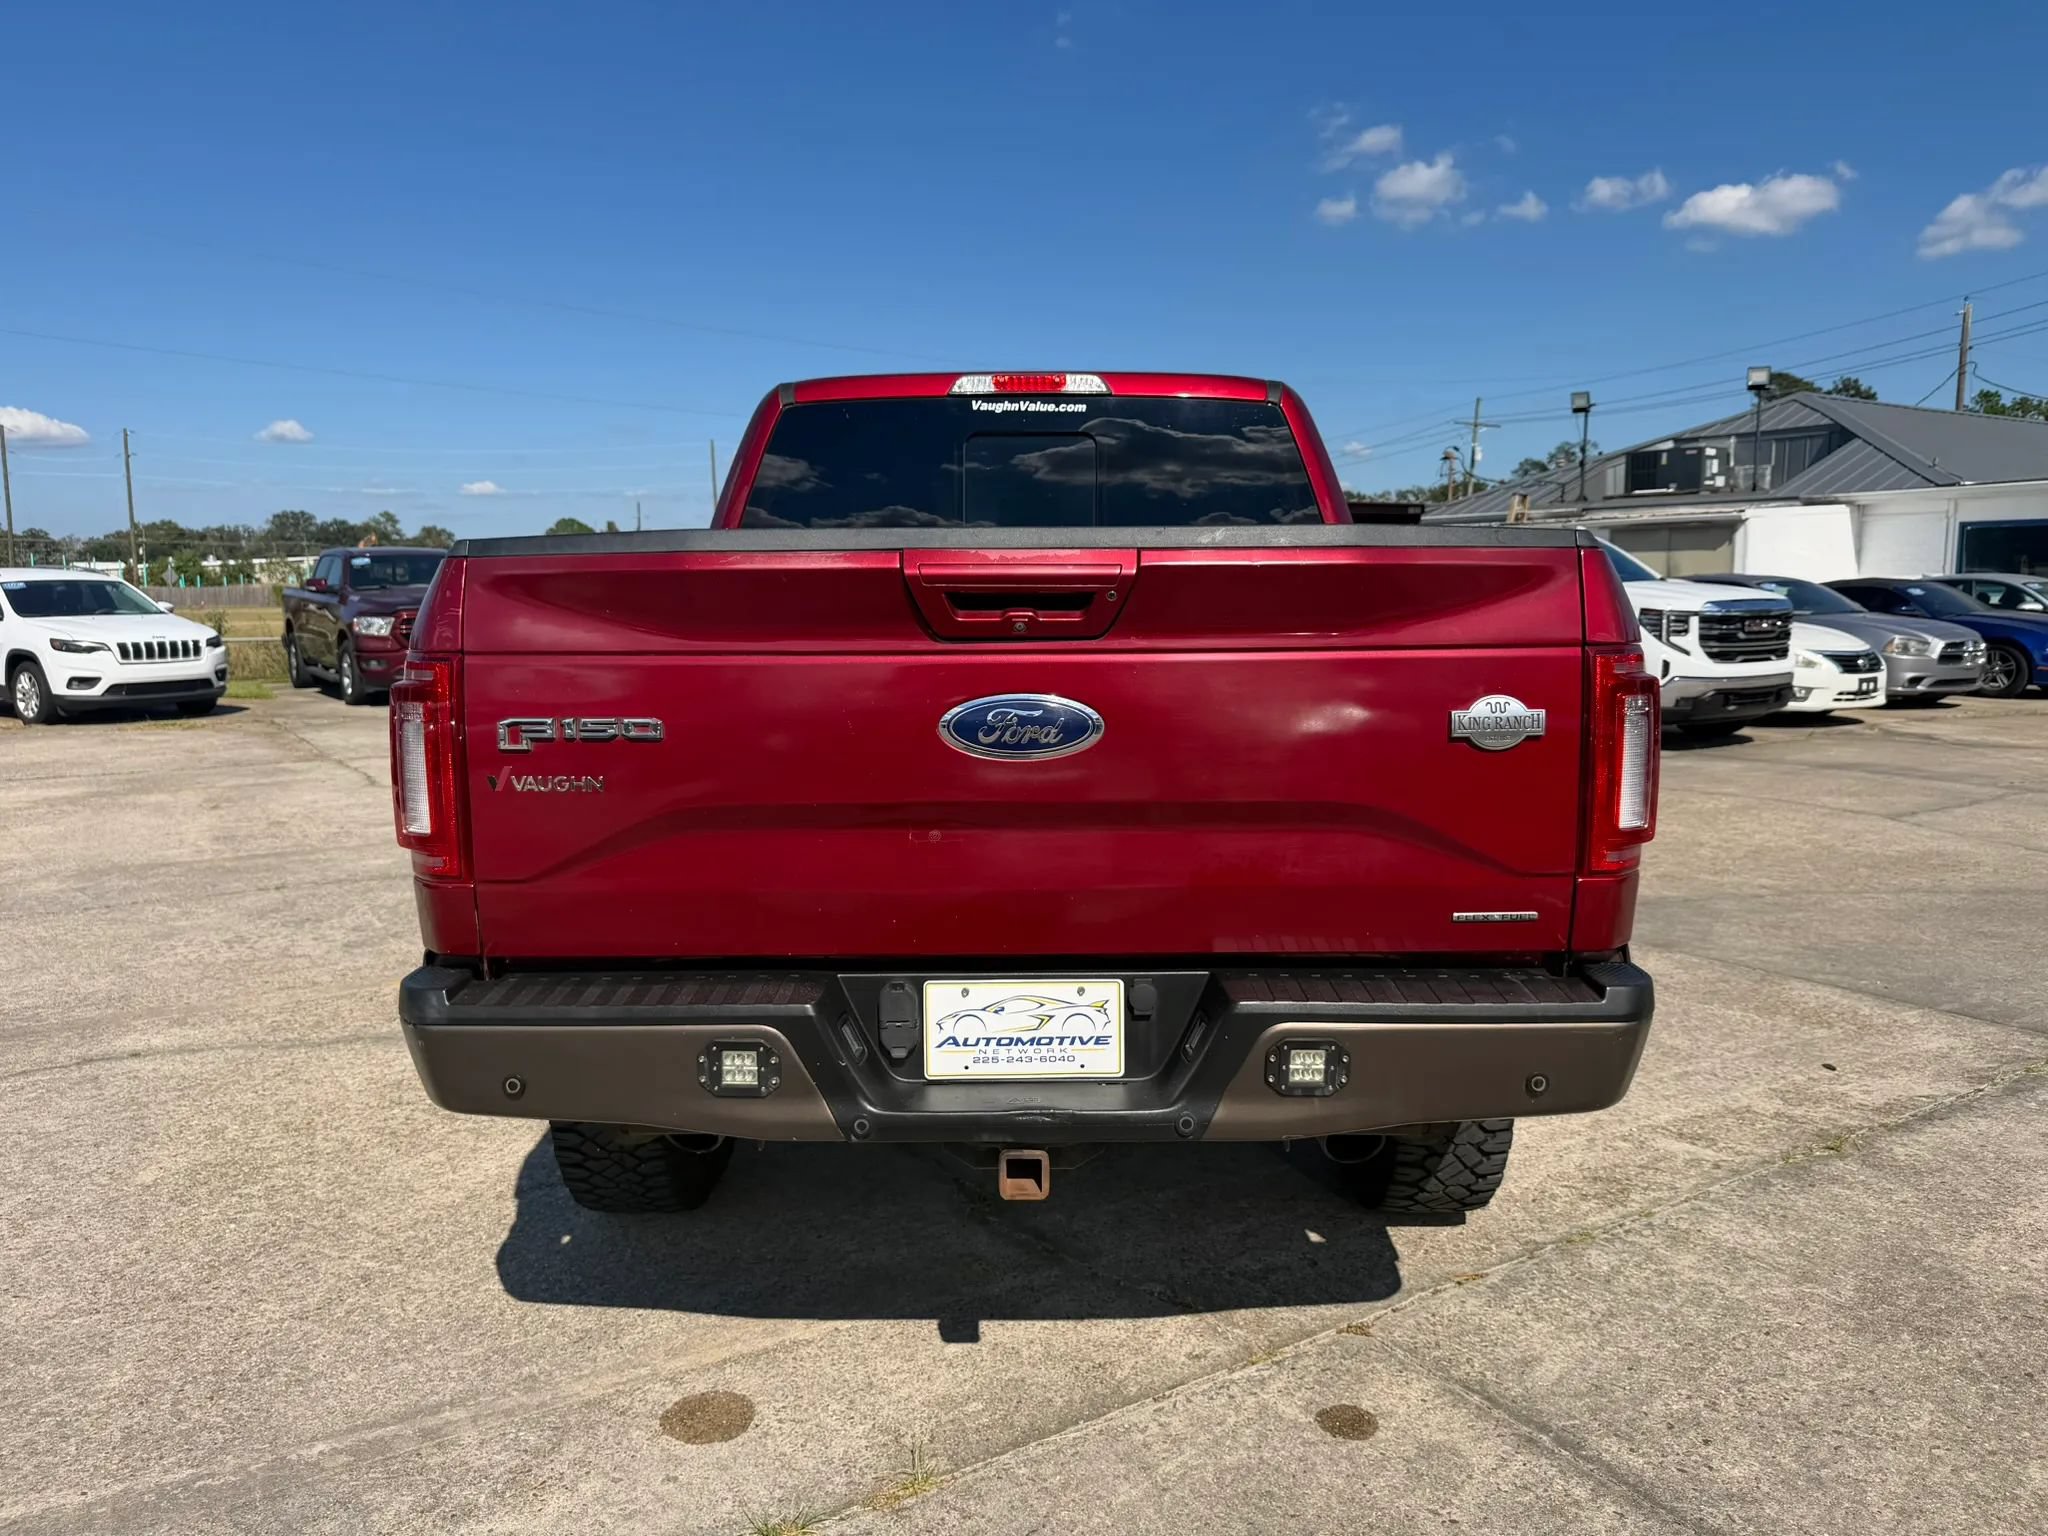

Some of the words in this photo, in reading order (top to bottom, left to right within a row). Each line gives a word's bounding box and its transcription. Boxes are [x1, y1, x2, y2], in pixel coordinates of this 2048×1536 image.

[971, 400, 1087, 413] VaughnValue.com
[977, 708, 1064, 744] Ford
[1457, 714, 1490, 731] KING
[1495, 713, 1541, 731] RANCH
[511, 775, 604, 792] VAUGHN
[935, 1035, 1112, 1048] AUTOMOTIVE
[972, 1055, 1076, 1064] 225-243-6040
